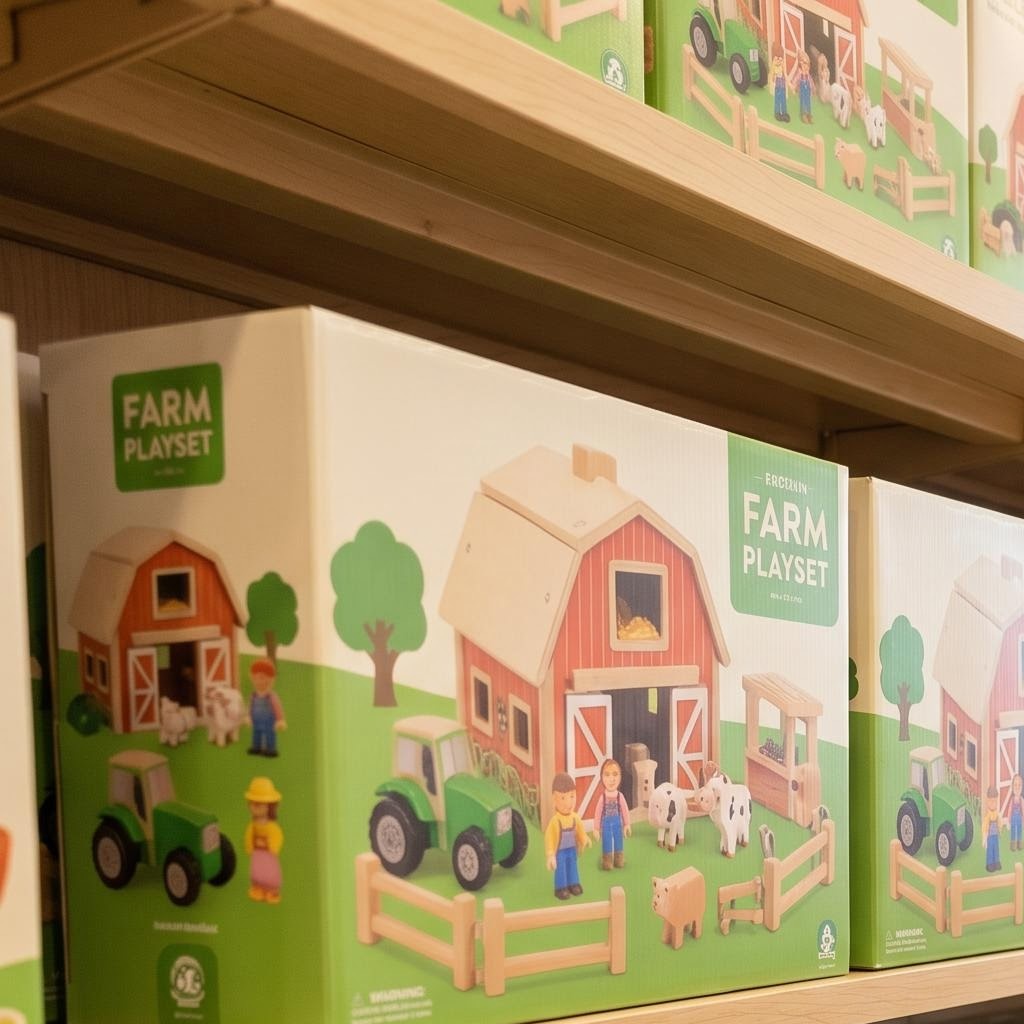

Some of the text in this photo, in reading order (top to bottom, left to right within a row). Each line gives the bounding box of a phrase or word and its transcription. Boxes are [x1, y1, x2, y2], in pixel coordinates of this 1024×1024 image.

[123, 384, 212, 429] FARM
[124, 430, 213, 462] PLAYSET
[743, 491, 828, 551] FARM
[743, 544, 829, 588] PLAYSET
